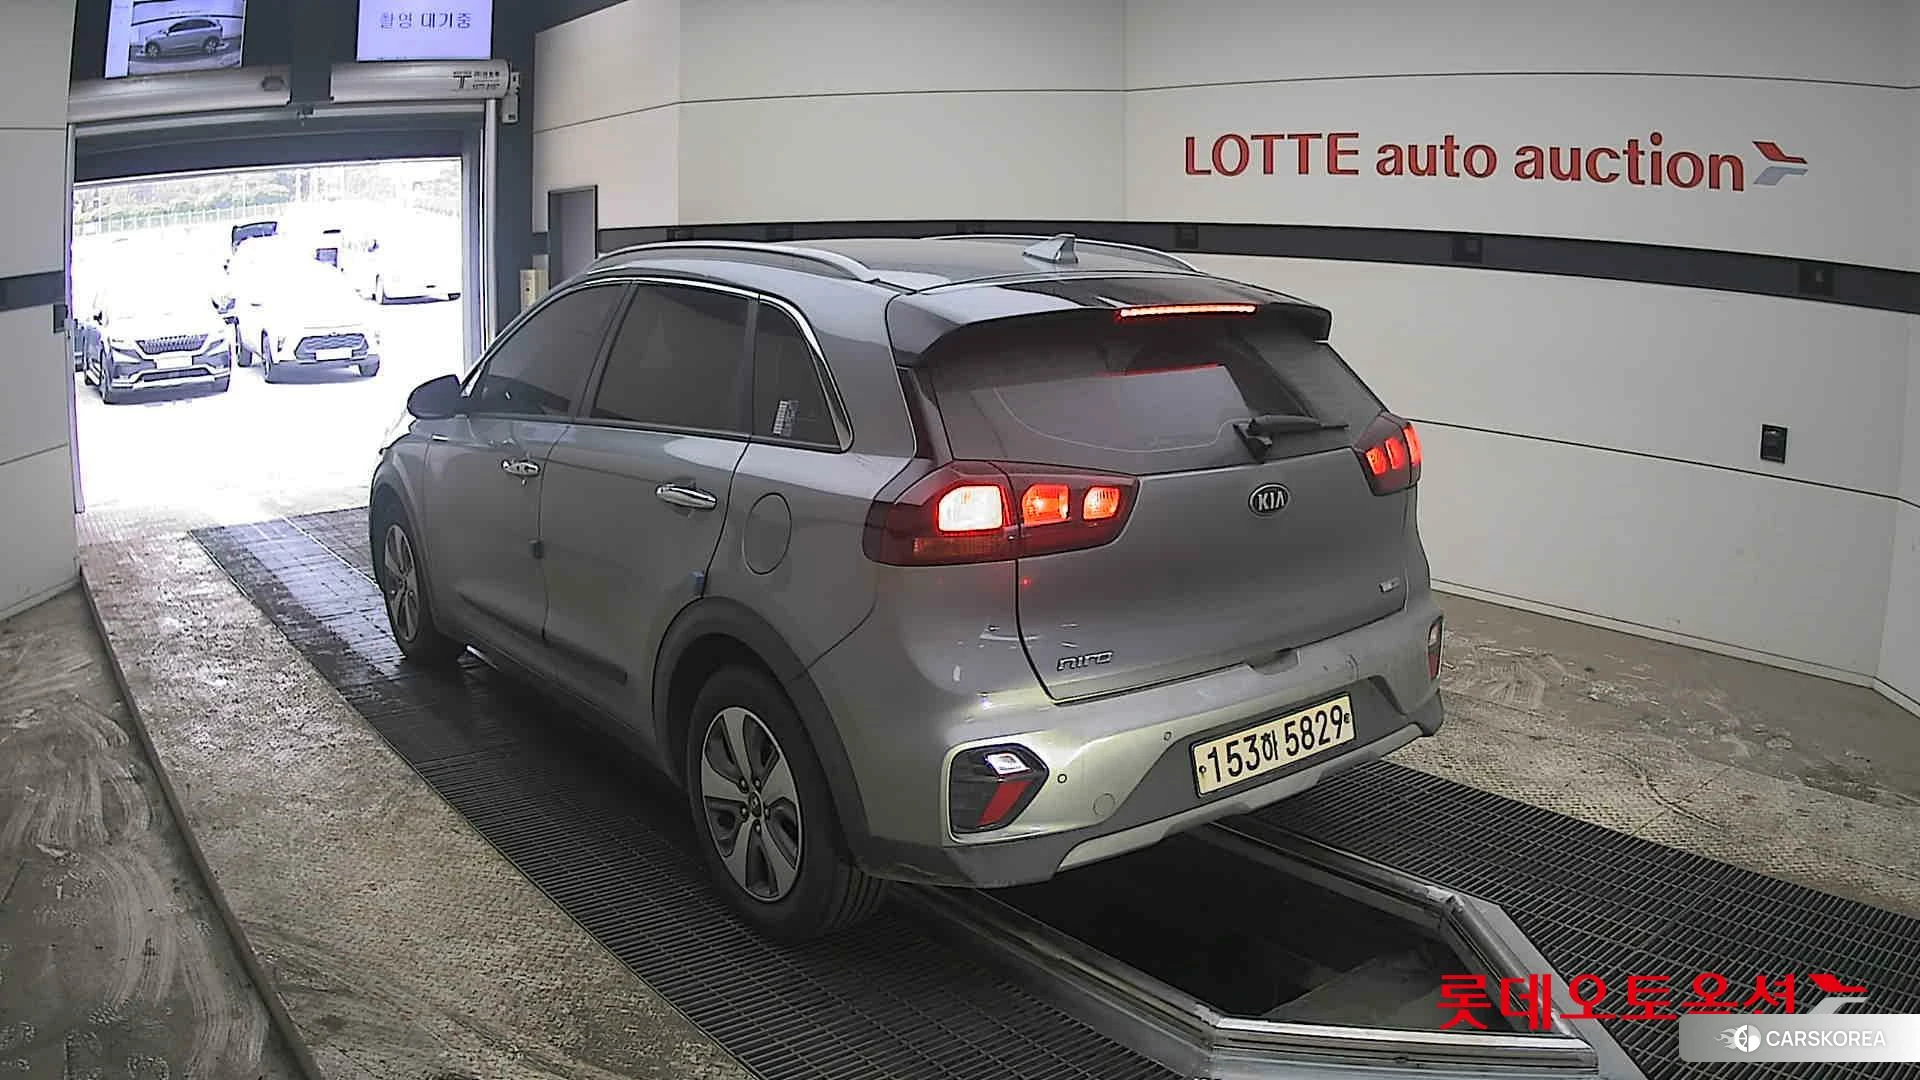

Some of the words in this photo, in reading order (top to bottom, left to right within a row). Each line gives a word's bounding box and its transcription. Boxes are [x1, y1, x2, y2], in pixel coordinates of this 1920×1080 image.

[421, 11, 472, 29] 대기중
[1184, 132, 1360, 176] LOTTE
[1375, 134, 1498, 178] auto
[1513, 131, 1745, 192] auction
[1257, 490, 1285, 511] KIA
[1284, 704, 1343, 757] 5829
